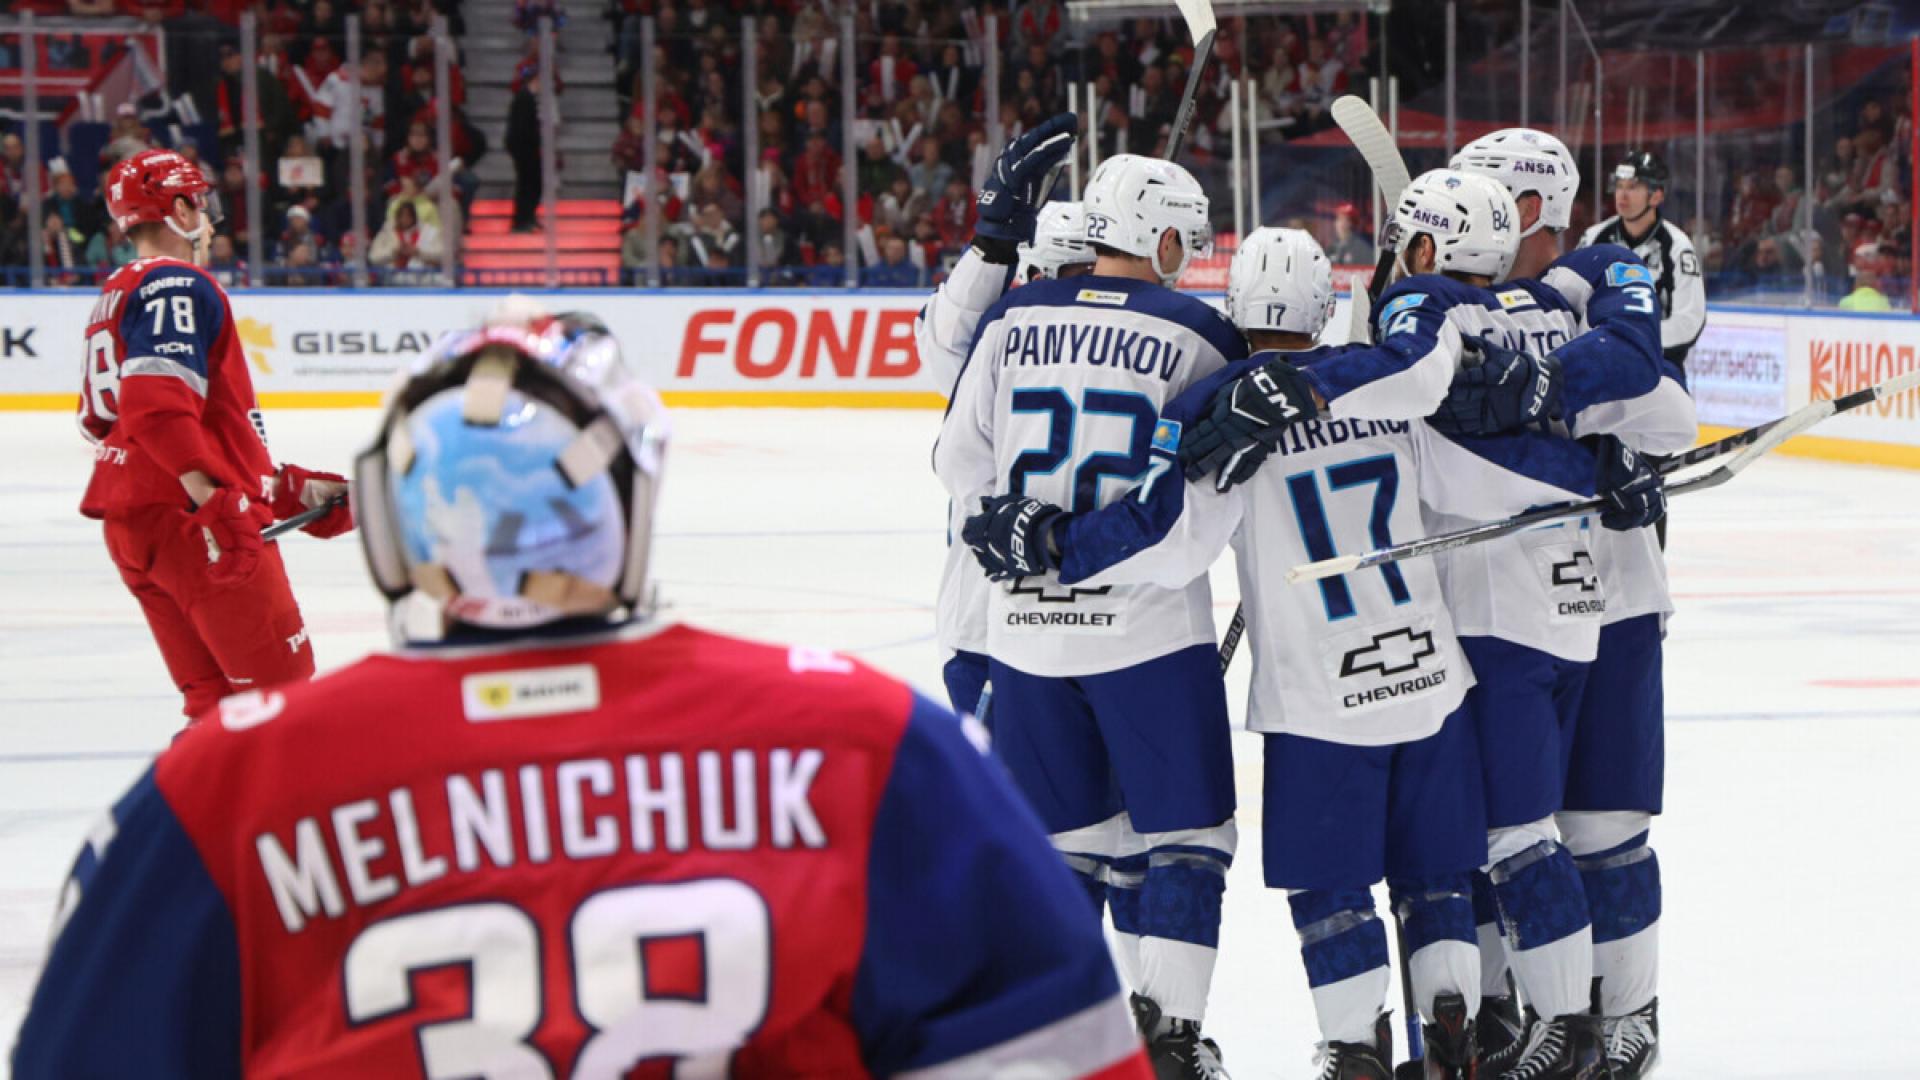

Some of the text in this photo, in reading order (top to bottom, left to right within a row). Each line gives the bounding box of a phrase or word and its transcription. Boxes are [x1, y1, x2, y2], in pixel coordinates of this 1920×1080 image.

[1513, 161, 1556, 175] ANSA
[1087, 216, 1107, 239] 22
[1413, 209, 1449, 230] ANSA
[1492, 210, 1511, 232] 84
[140, 276, 196, 299] FONBET
[145, 295, 196, 335] 78
[1266, 304, 1286, 327] 17
[1004, 325, 1183, 383] PANYUKOV
[1250, 366, 1300, 419] CM
[1009, 387, 1160, 513] 22
[1010, 499, 1045, 573] AUER
[1286, 453, 1411, 622] 17
[1007, 612, 1117, 627] CHEVROLET
[1343, 669, 1447, 708] CHEVROLET
[256, 747, 828, 934] MELNICHUK
[343, 875, 773, 1080] 38
